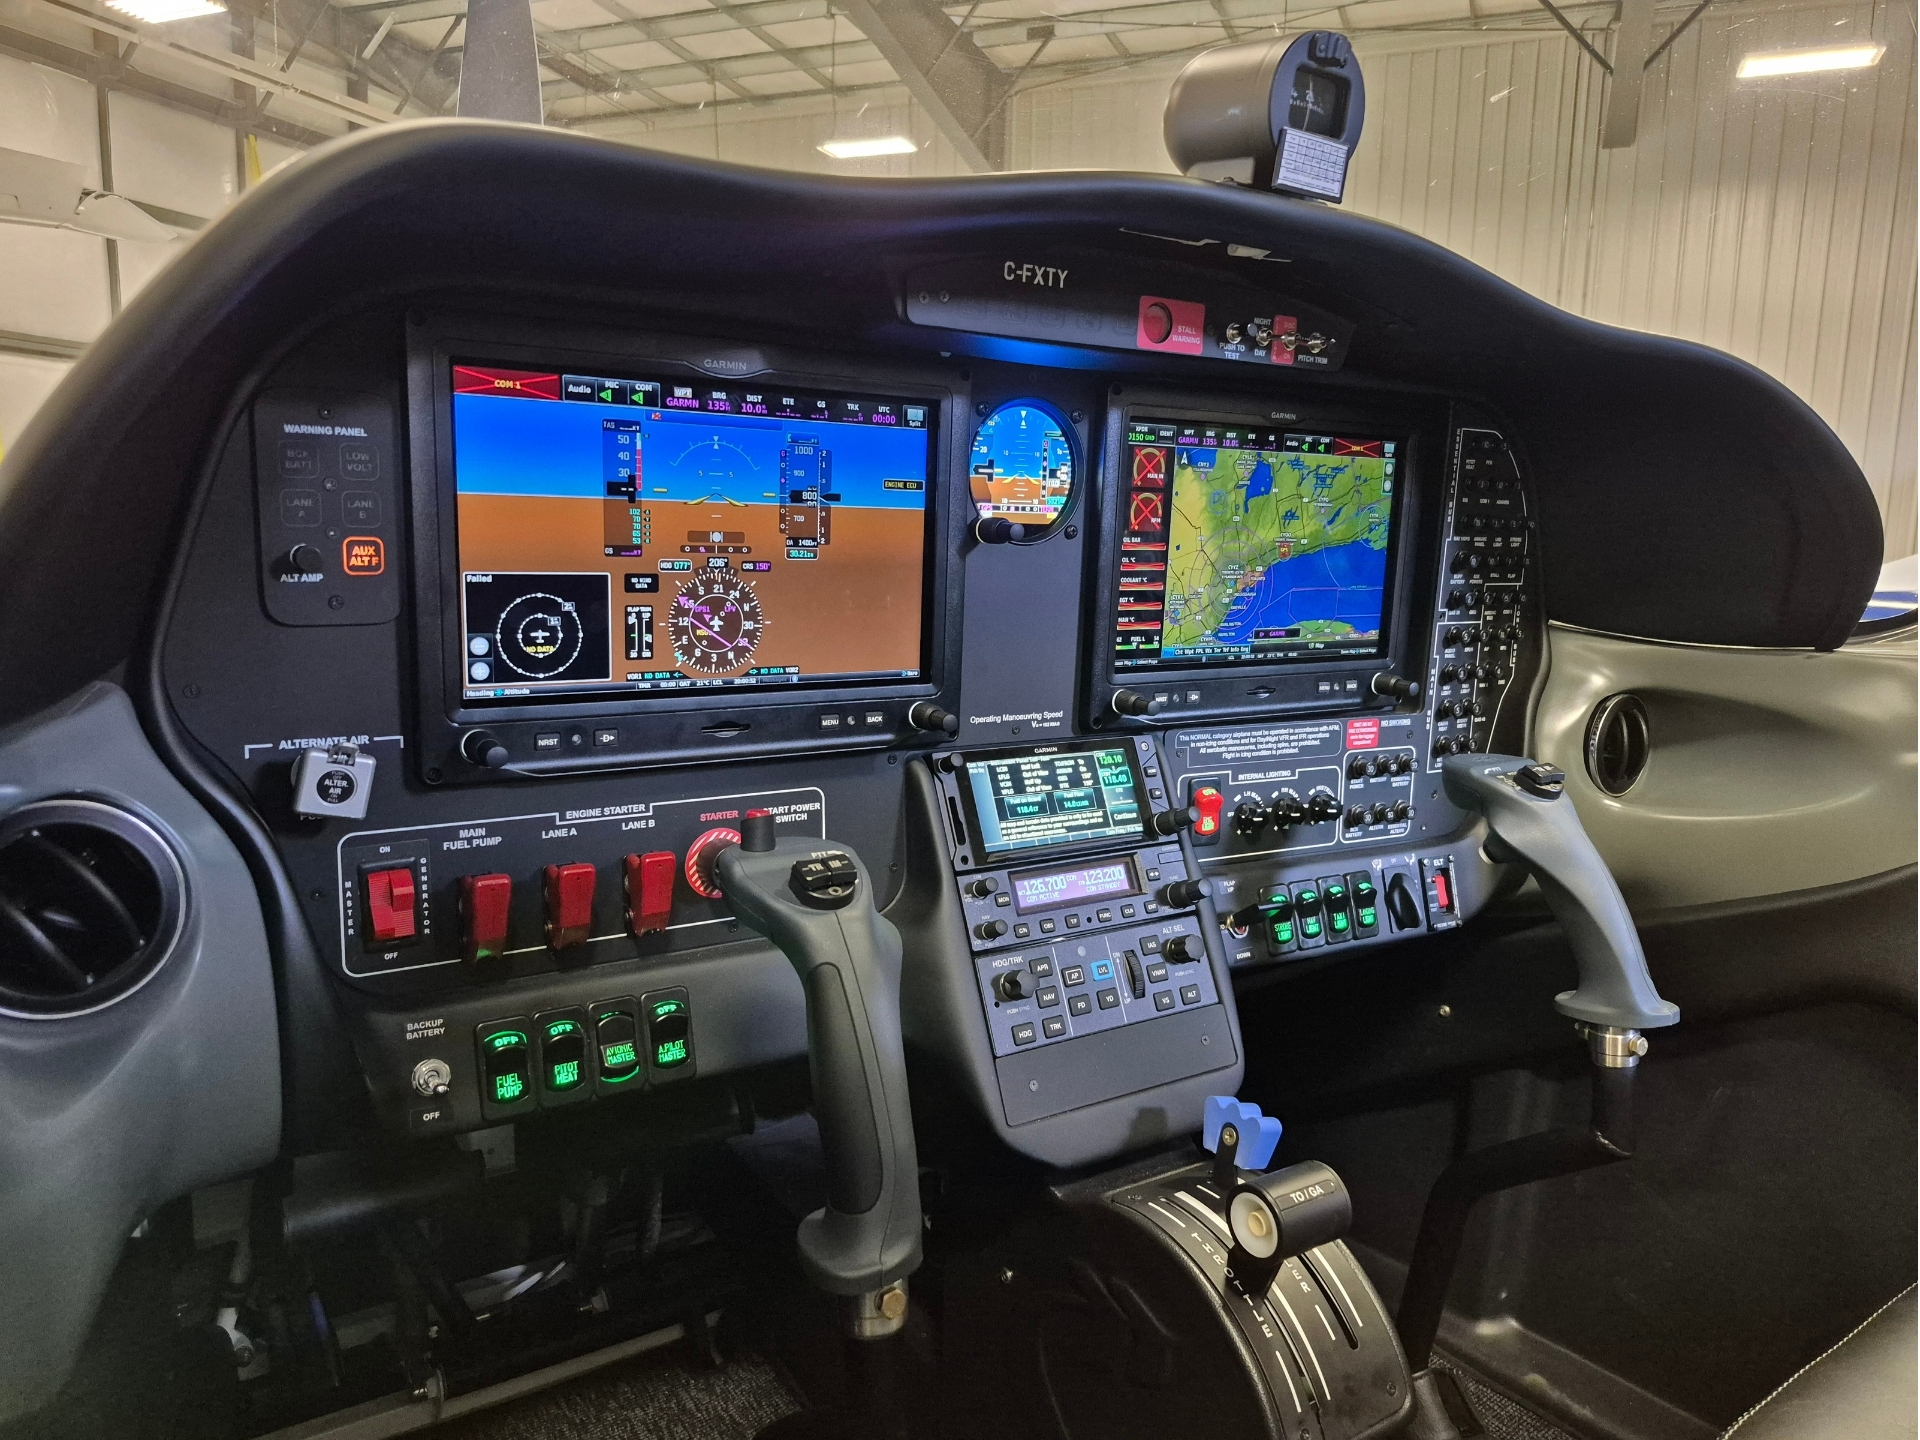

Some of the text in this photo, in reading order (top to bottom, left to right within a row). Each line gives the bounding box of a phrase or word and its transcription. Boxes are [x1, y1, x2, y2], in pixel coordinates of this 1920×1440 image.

[1004, 261, 1068, 288] C-FXTY
[1254, 318, 1271, 326] NIGHT
[1177, 326, 1196, 334] STALL
[1172, 334, 1200, 345] WARNING
[1219, 343, 1235, 351] PUSH
[1254, 349, 1266, 357] DAY
[704, 359, 746, 370] GARMIN
[1298, 355, 1327, 364] PITCH TRIM
[494, 379, 521, 388] COM 1
[568, 384, 591, 393] Audio
[635, 383, 652, 391] COM
[674, 388, 691, 396] WPT
[666, 398, 699, 408] GARMN
[872, 415, 895, 424] 00:00
[1271, 412, 1296, 420] GARMIN
[284, 424, 367, 436] WARNING PANEL
[618, 435, 629, 444] 50
[795, 446, 813, 455] 1000
[618, 452, 630, 460] 40
[352, 545, 376, 556] AUX
[349, 556, 379, 566] ALT F
[281, 573, 323, 582] ALT AMP
[467, 575, 492, 583] Failed
[714, 585, 723, 593] 21
[467, 689, 494, 698] Heading
[822, 718, 839, 726] MENU
[970, 711, 1063, 724] Operating Manoeuvring Speed
[279, 735, 369, 750] ALTERNATE AIR
[1238, 770, 1291, 780] INTERNAL LIGHTING
[324, 779, 348, 788] ALTER.
[329, 787, 342, 795] AIR
[566, 803, 646, 819] ENGINE STARTER
[762, 802, 821, 815] TART POWER
[700, 810, 739, 822] STARTER
[775, 813, 808, 824] SWITCH
[622, 819, 656, 830] LANE B
[459, 828, 486, 838] MAIN
[542, 827, 577, 839] LANE A
[443, 836, 502, 850] FUEL PUMP
[1433, 858, 1444, 866] ELT
[1083, 866, 1125, 885] 123.200
[1024, 876, 1067, 896] 126.700
[1098, 882, 1120, 891] STANDBY
[420, 857, 430, 935] GENERATOR
[1026, 892, 1060, 903] COM ACTIVE
[344, 881, 355, 935] MASTER
[1163, 926, 1172, 934] ALT
[1274, 922, 1291, 932] STROBE
[384, 952, 398, 960] OFF
[1237, 952, 1251, 960] DOWN
[992, 956, 1024, 968] HDG/TRK
[1071, 972, 1079, 980] AP
[1152, 969, 1166, 977] VNAV
[1043, 993, 1055, 1001] NAV
[657, 1004, 677, 1014] OFF
[407, 1018, 444, 1031] BACKUP
[550, 1024, 573, 1035] OFF
[406, 1027, 446, 1040] BATTERY
[1019, 1030, 1033, 1038] HDG
[494, 1036, 519, 1047] OFF
[658, 1040, 684, 1053] A.PILOT
[606, 1044, 634, 1056] AVIONIC
[606, 1052, 636, 1065] MASTER
[658, 1049, 686, 1062] MASTER
[554, 1061, 579, 1075] PITOT
[496, 1074, 522, 1088] FUEL
[556, 1070, 579, 1085] HEAT
[497, 1084, 523, 1099] PUMP
[423, 1112, 440, 1121] OFF
[1191, 1232, 1273, 1338] THROTTLE
